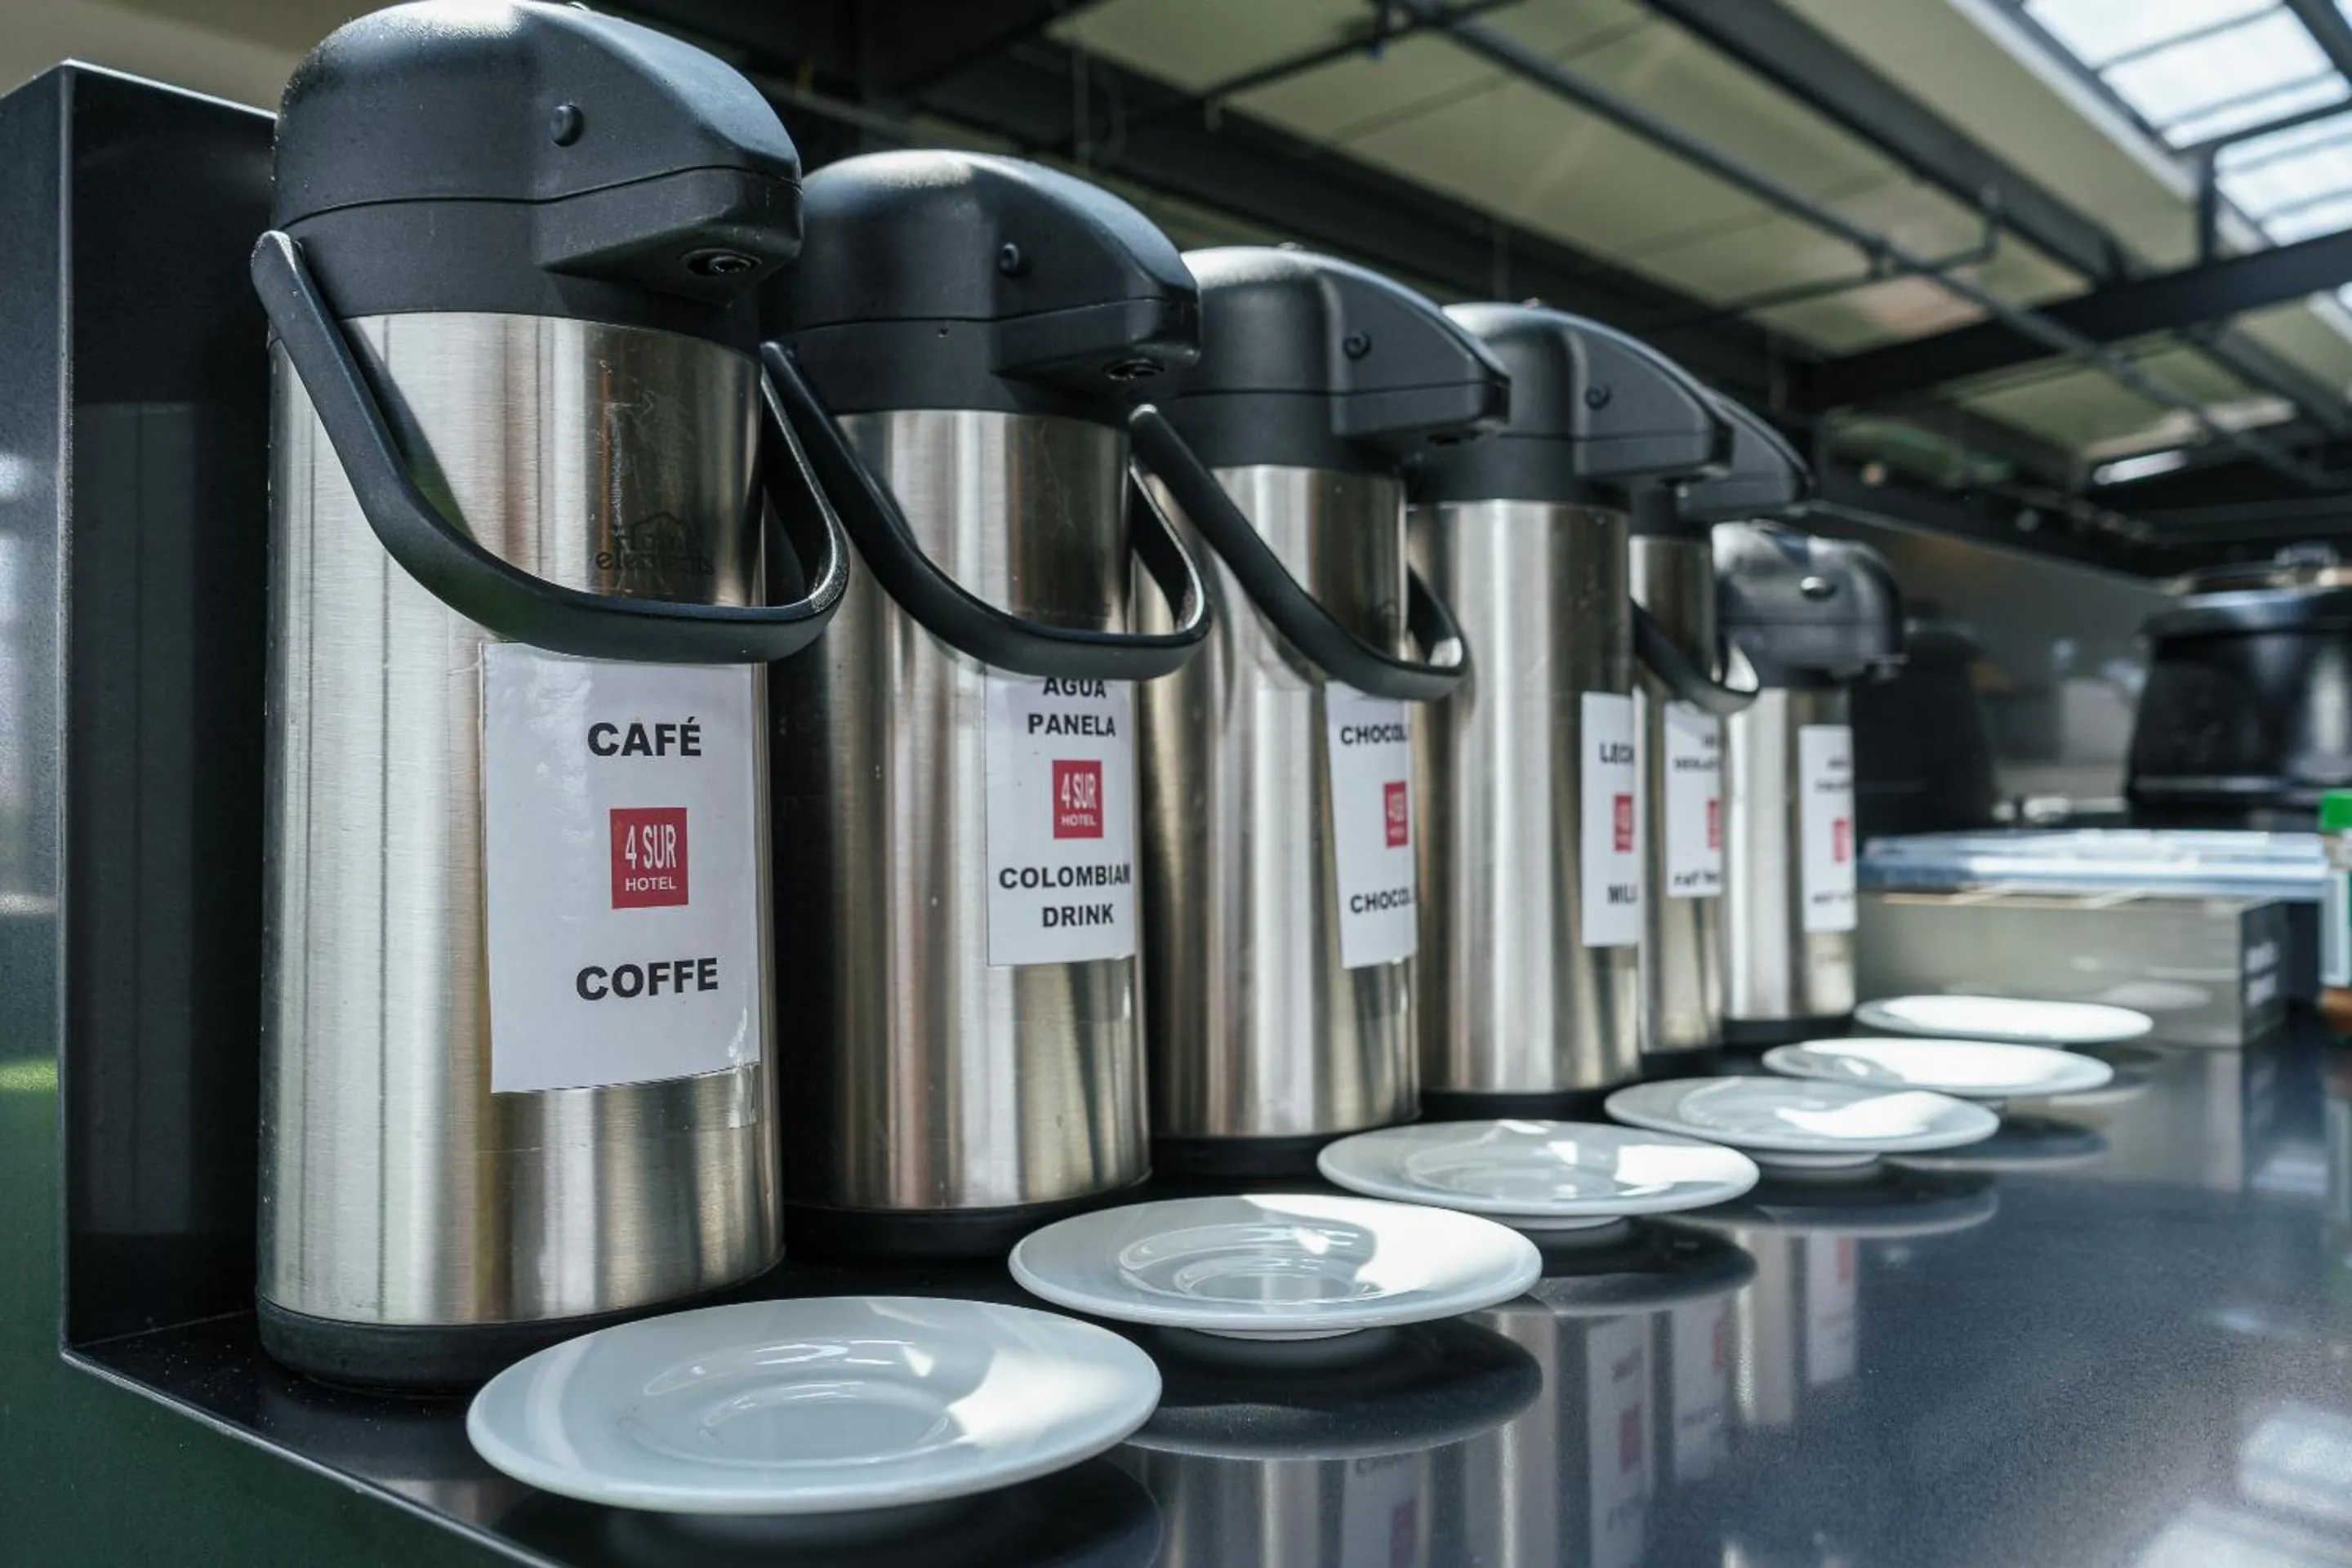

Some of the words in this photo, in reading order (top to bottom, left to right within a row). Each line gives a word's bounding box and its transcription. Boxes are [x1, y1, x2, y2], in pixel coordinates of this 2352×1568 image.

[1043, 678, 1107, 698] AGUA
[587, 715, 702, 757] CAFÉ
[1027, 713, 1116, 737] PANELA
[1061, 773, 1071, 809] 4
[1072, 773, 1097, 809] SUR
[1061, 813, 1097, 826] HOTEL
[625, 825, 637, 870] 4
[642, 824, 677, 870] SUR
[625, 875, 677, 892] HOTEL
[999, 863, 1131, 889] COLOMBIAN
[1042, 902, 1114, 928] DRINK
[576, 956, 719, 1001] COFFE
